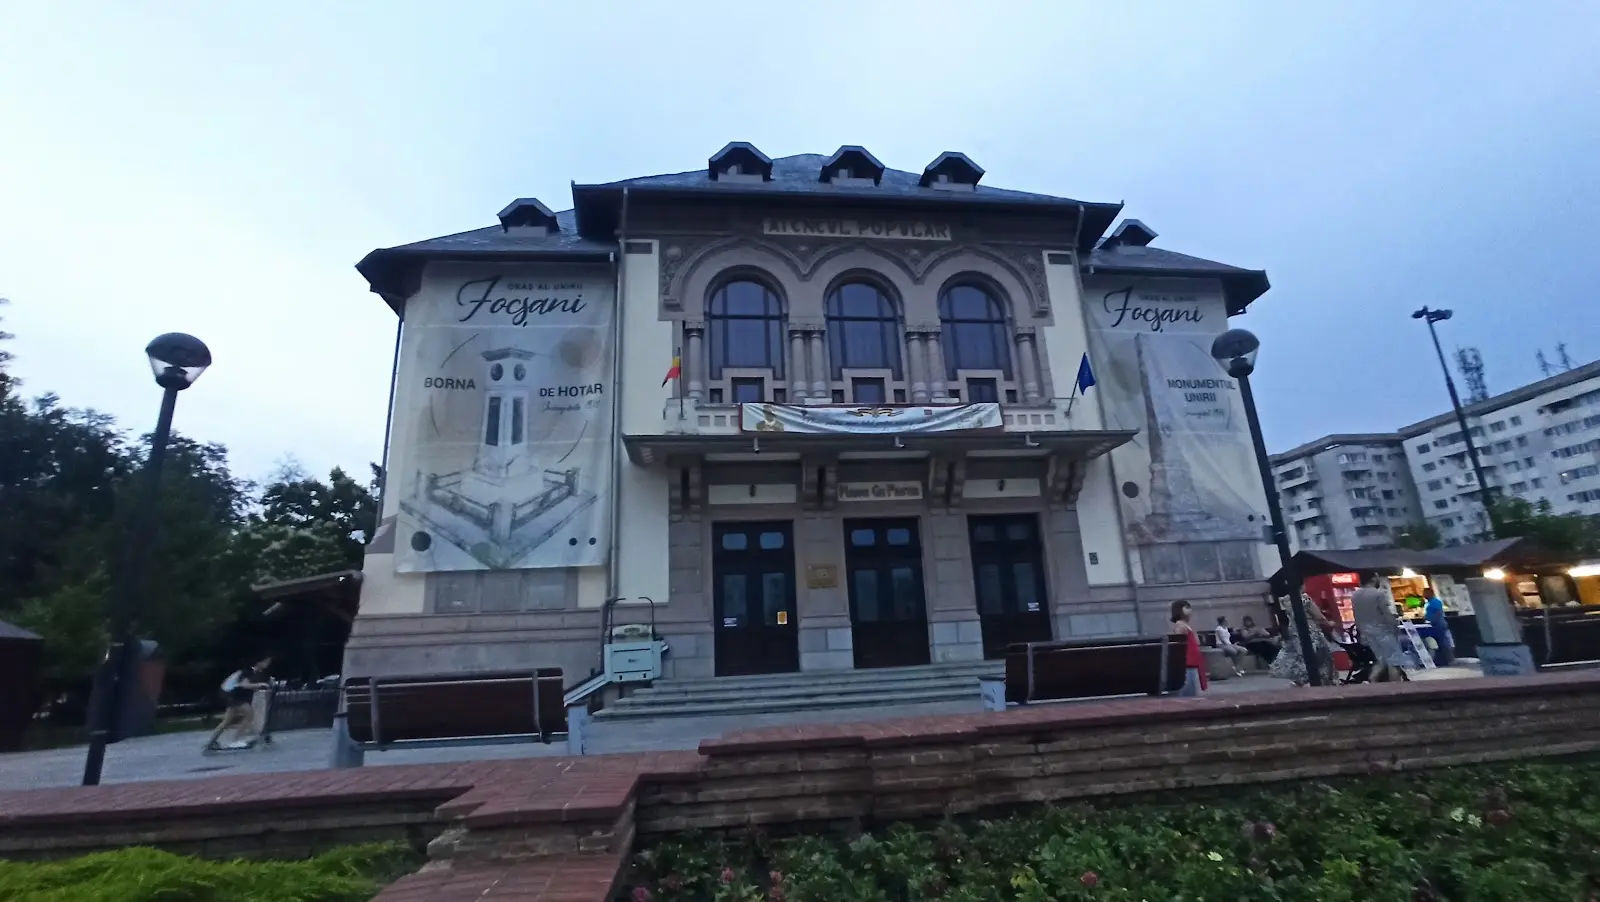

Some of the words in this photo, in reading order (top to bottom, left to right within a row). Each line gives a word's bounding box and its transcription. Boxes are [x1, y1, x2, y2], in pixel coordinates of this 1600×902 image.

[857, 221, 948, 238] POPULAR
[424, 377, 476, 390] BORNA
[539, 387, 555, 397] DE
[557, 383, 603, 397] HOTAR
[1167, 378, 1236, 390] MONUMENTUL
[1184, 392, 1217, 402] UNIRII
